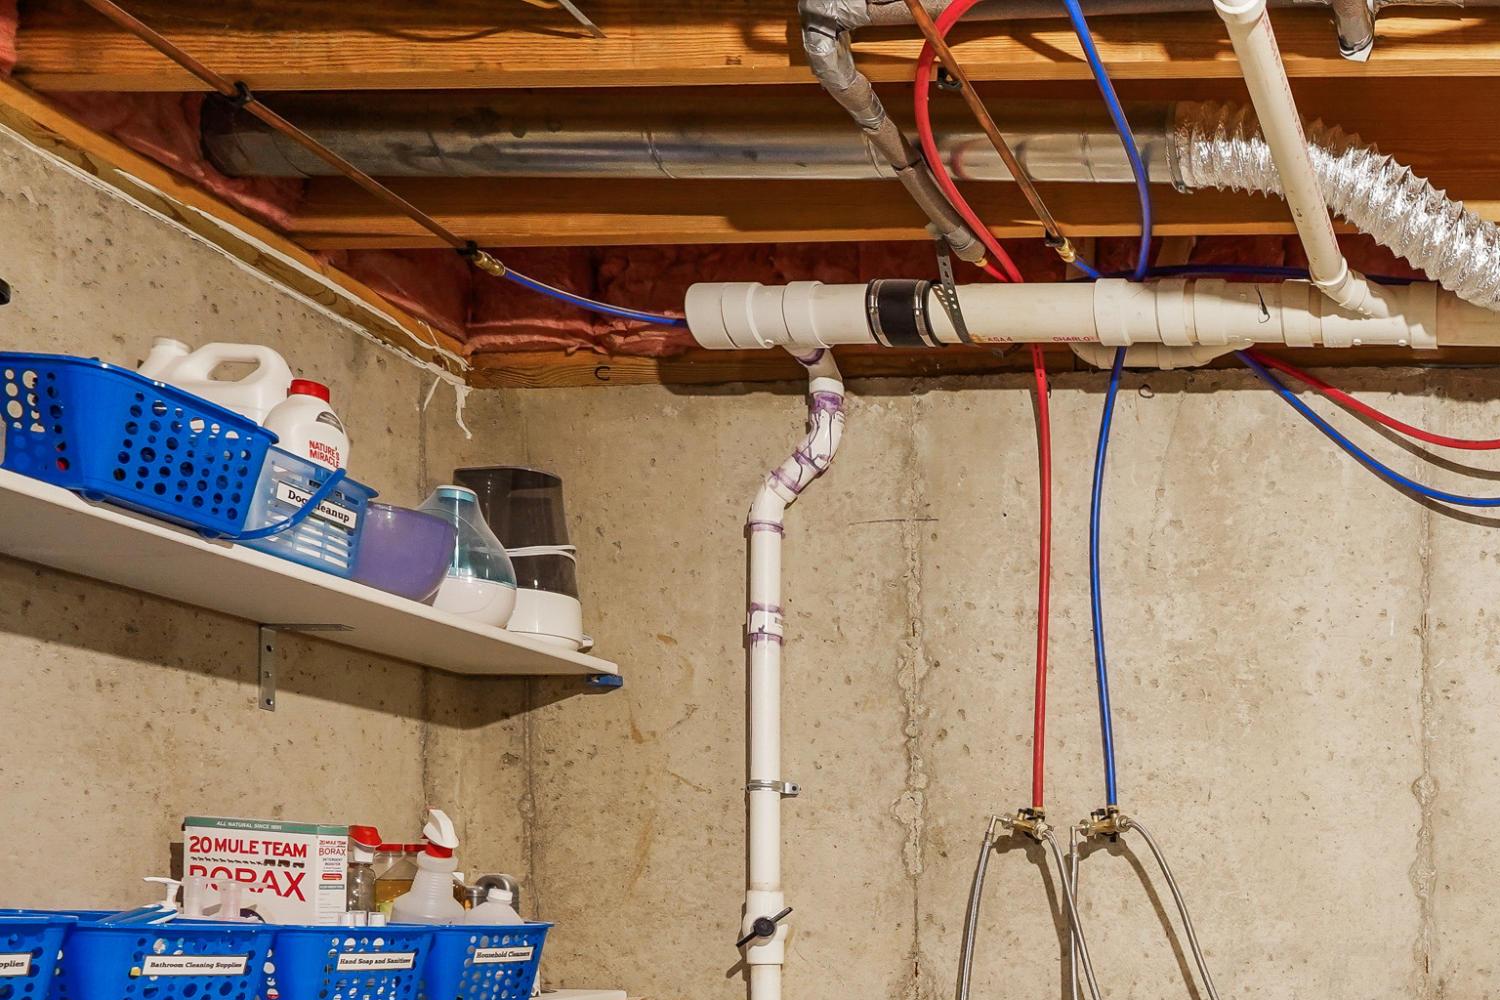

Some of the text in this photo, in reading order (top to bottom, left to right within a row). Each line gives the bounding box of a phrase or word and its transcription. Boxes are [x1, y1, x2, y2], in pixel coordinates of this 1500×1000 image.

[309, 440, 340, 461] NATURE'S
[309, 449, 340, 469] MIRACLE
[317, 503, 350, 522] leanup
[228, 821, 252, 829] NATURAL
[190, 836, 307, 858] 20 MULE TEAM
[319, 847, 346, 857] BORAX
[185, 961, 214, 969] Cleaning
[358, 957, 374, 966] Soap
[375, 957, 385, 965] and
